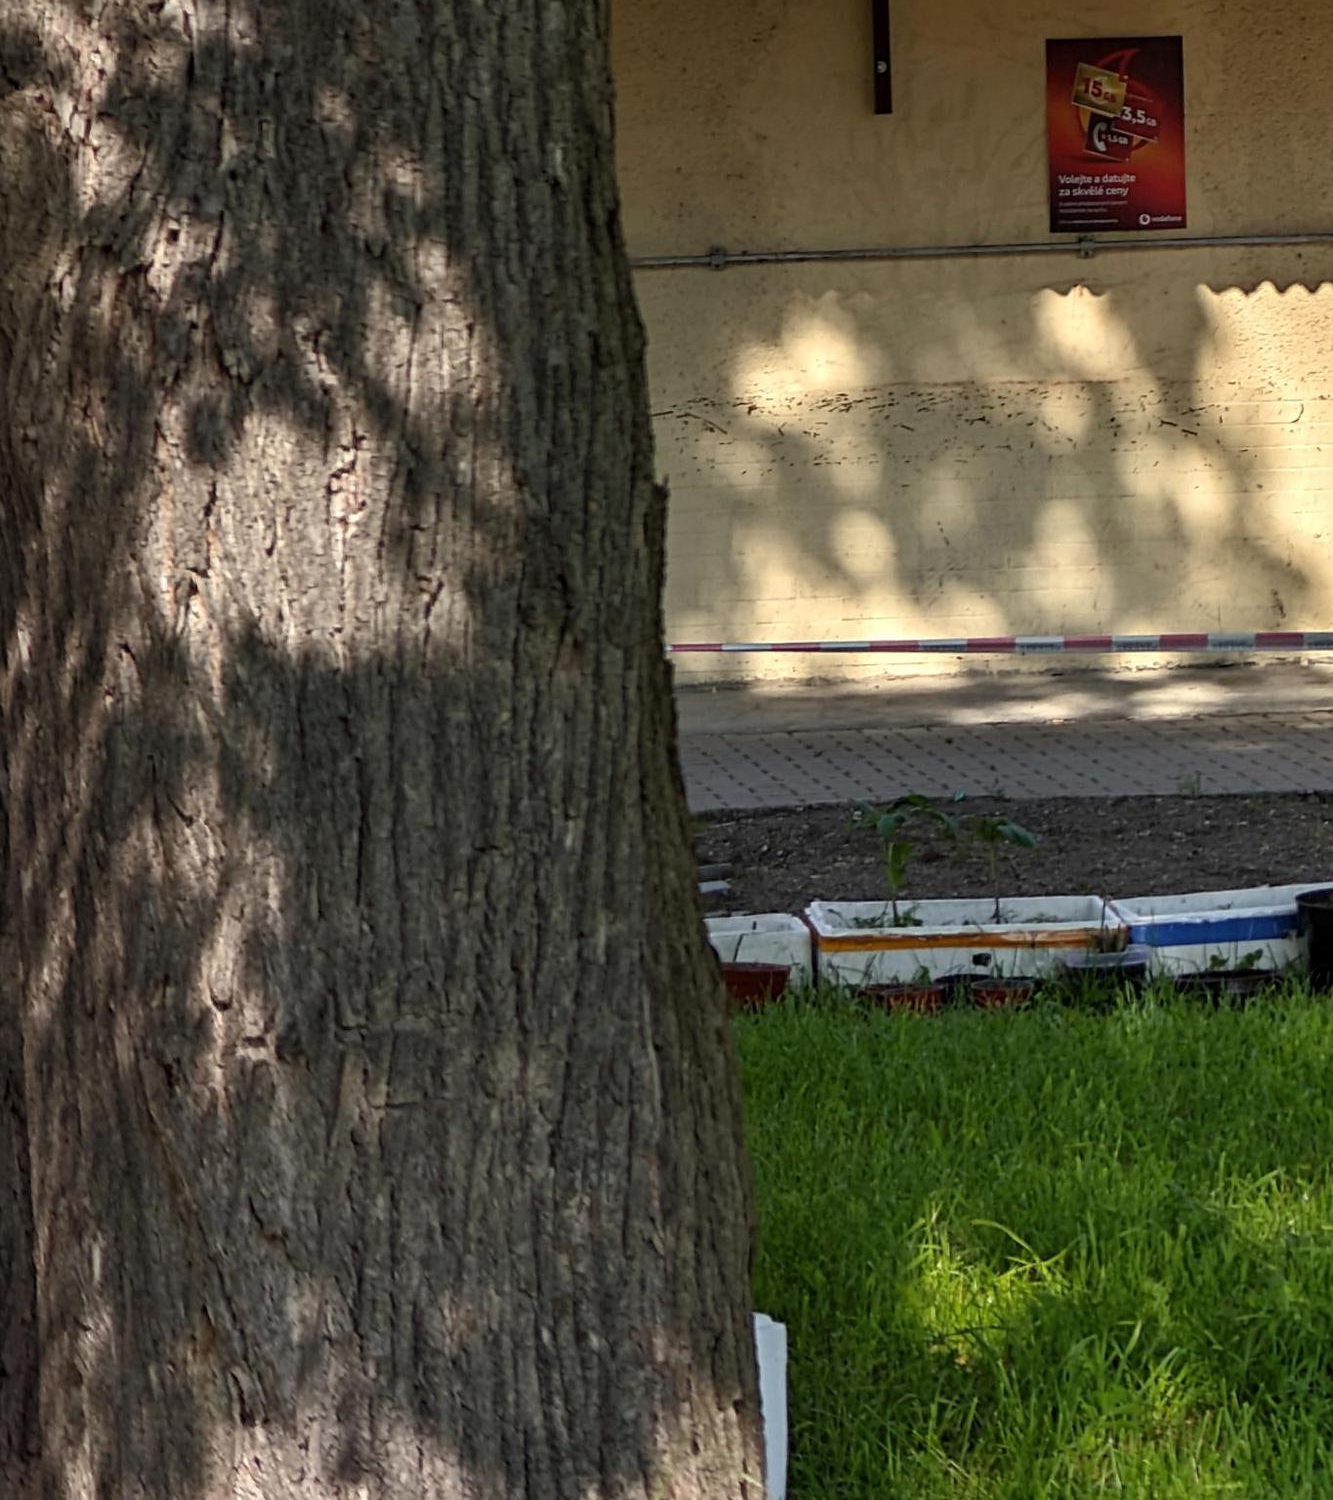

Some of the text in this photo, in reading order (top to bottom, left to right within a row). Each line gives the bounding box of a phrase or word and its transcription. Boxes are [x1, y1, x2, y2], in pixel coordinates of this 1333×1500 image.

[1058, 174, 1093, 185] Volejte
[1058, 188, 1071, 196] za
[1105, 187, 1129, 197] ceny
